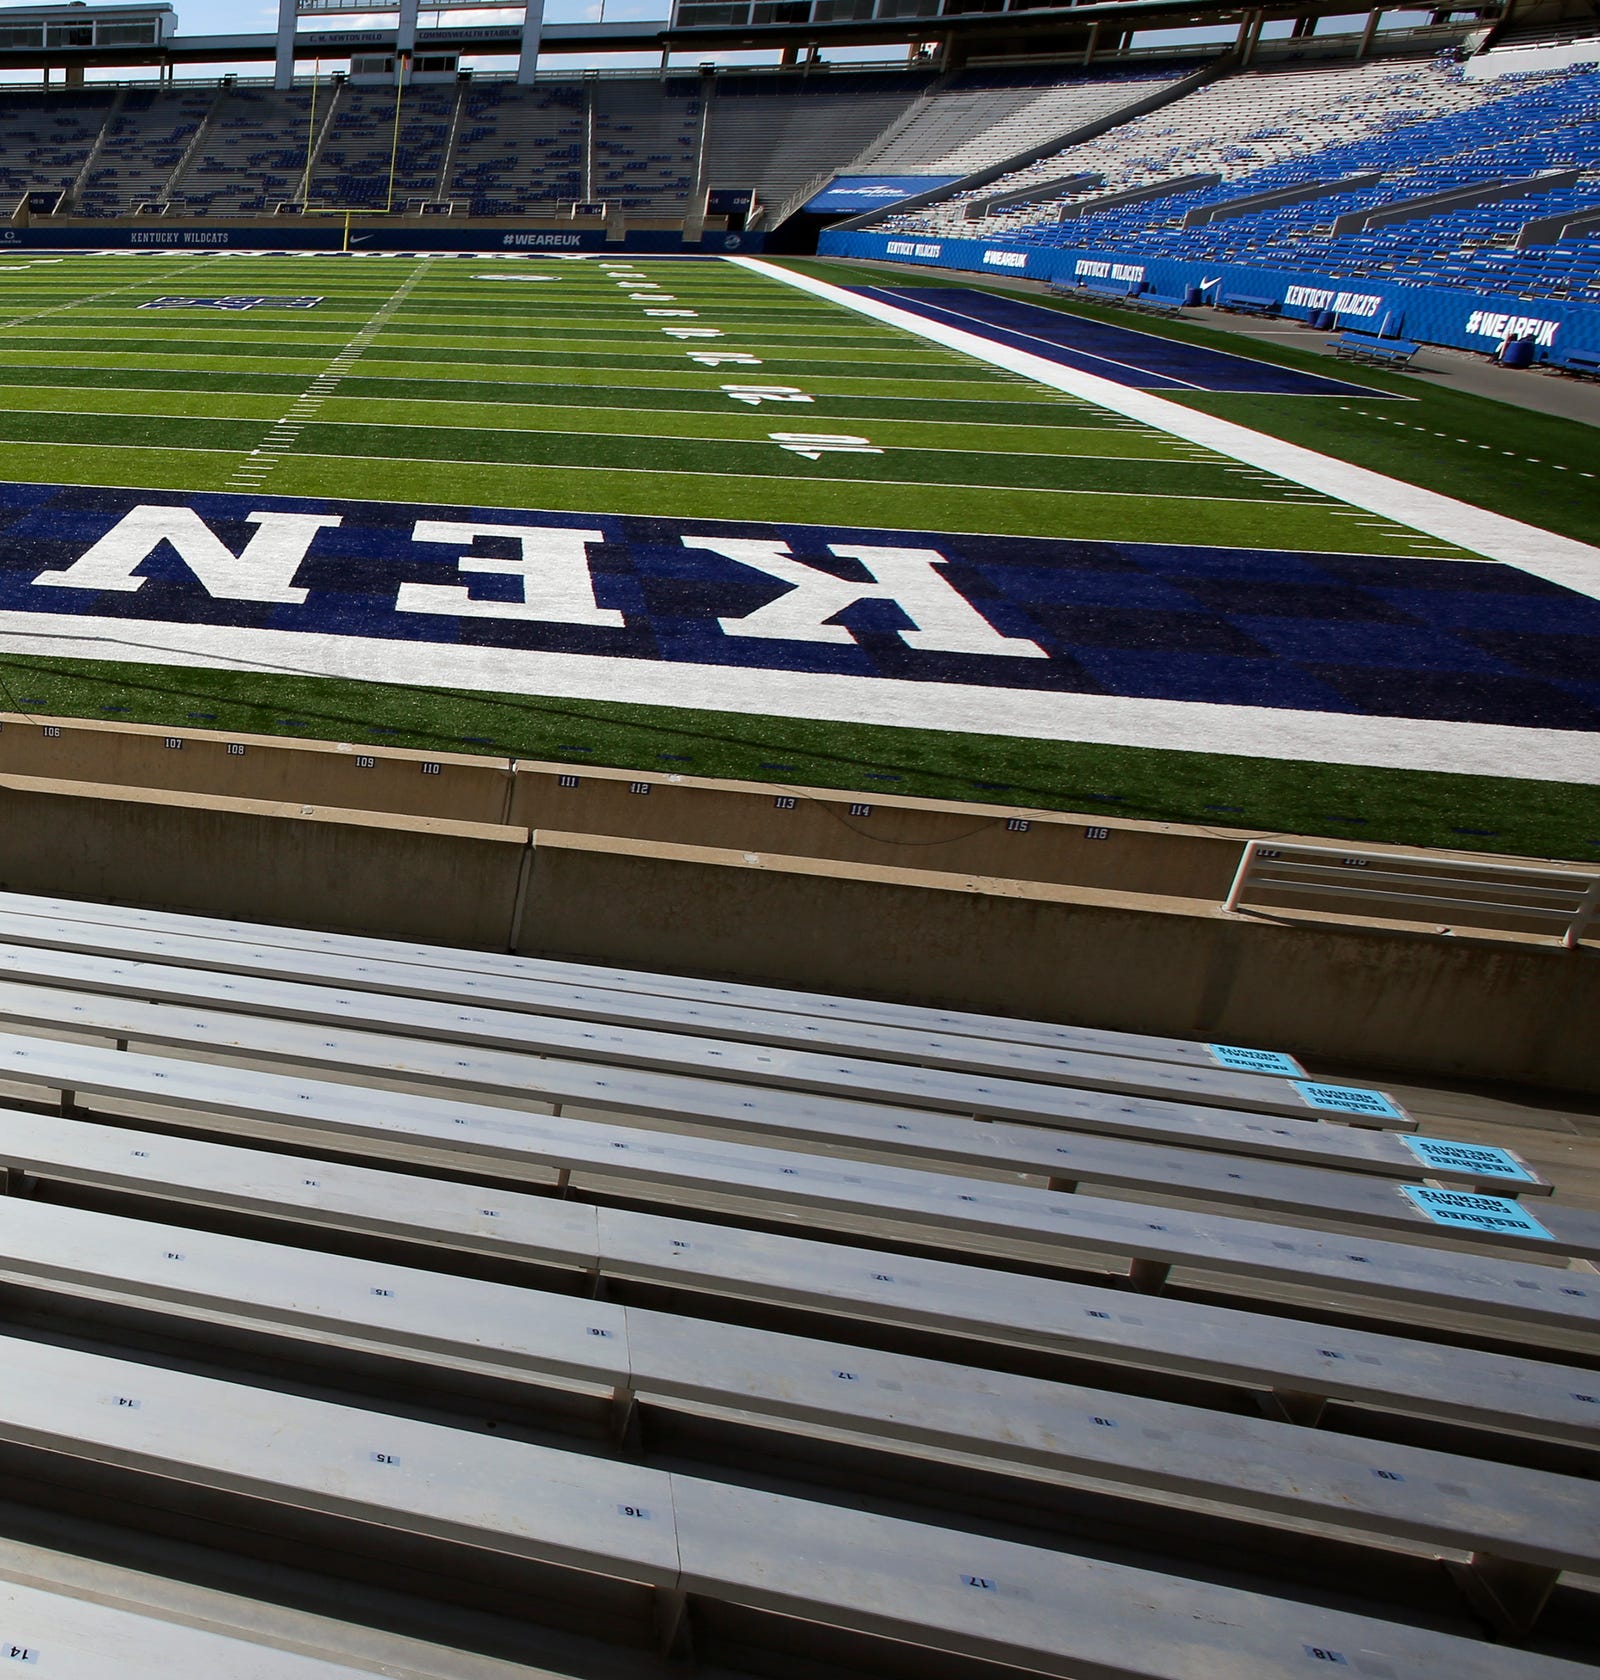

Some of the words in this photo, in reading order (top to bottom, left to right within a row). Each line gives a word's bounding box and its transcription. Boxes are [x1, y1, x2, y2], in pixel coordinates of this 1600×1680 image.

[131, 232, 178, 243] KENTUCKY
[184, 232, 229, 243] WILDCATS
[503, 234, 581, 246] #WEAREUK
[886, 241, 914, 256] KENTUCKY
[983, 250, 1028, 268] #WEAREUK
[1075, 260, 1111, 278] KENTUCKY
[1110, 264, 1144, 282] WILDCATS
[1284, 285, 1336, 311] KENTUCKY
[1332, 291, 1382, 317] WILDCATS
[1465, 310, 1560, 347] #WEAREUK
[43, 726, 60, 737] 106
[165, 738, 182, 749] 107
[227, 744, 244, 755] 108
[356, 757, 374, 768] 109
[423, 763, 439, 774] 110
[560, 776, 576, 787] 111
[631, 782, 649, 793] 112
[776, 798, 795, 809] 113
[851, 804, 870, 815] 114
[1007, 820, 1029, 831] 115
[1086, 827, 1108, 839] 116
[1314, 1098, 1387, 1112] RESERVED
[1419, 1143, 1497, 1159] RECRUITS
[1425, 1148, 1504, 1163] FOOTBALL
[1429, 1155, 1516, 1173] RESERVED
[1418, 1190, 1504, 1207] RECRUITS
[1425, 1197, 1513, 1214] FOOTBALL
[1433, 1209, 1532, 1230] RESERVED
[592, 1328, 606, 1337] 16
[838, 1372, 853, 1380] 17
[119, 1398, 133, 1407] 14
[1094, 1417, 1111, 1427] 18
[377, 1454, 393, 1464] 15
[1377, 1470, 1397, 1480] 19
[624, 1506, 643, 1517] 16
[969, 1577, 989, 1589] 17
[10, 1646, 28, 1659] 14
[1313, 1649, 1335, 1662] 18
